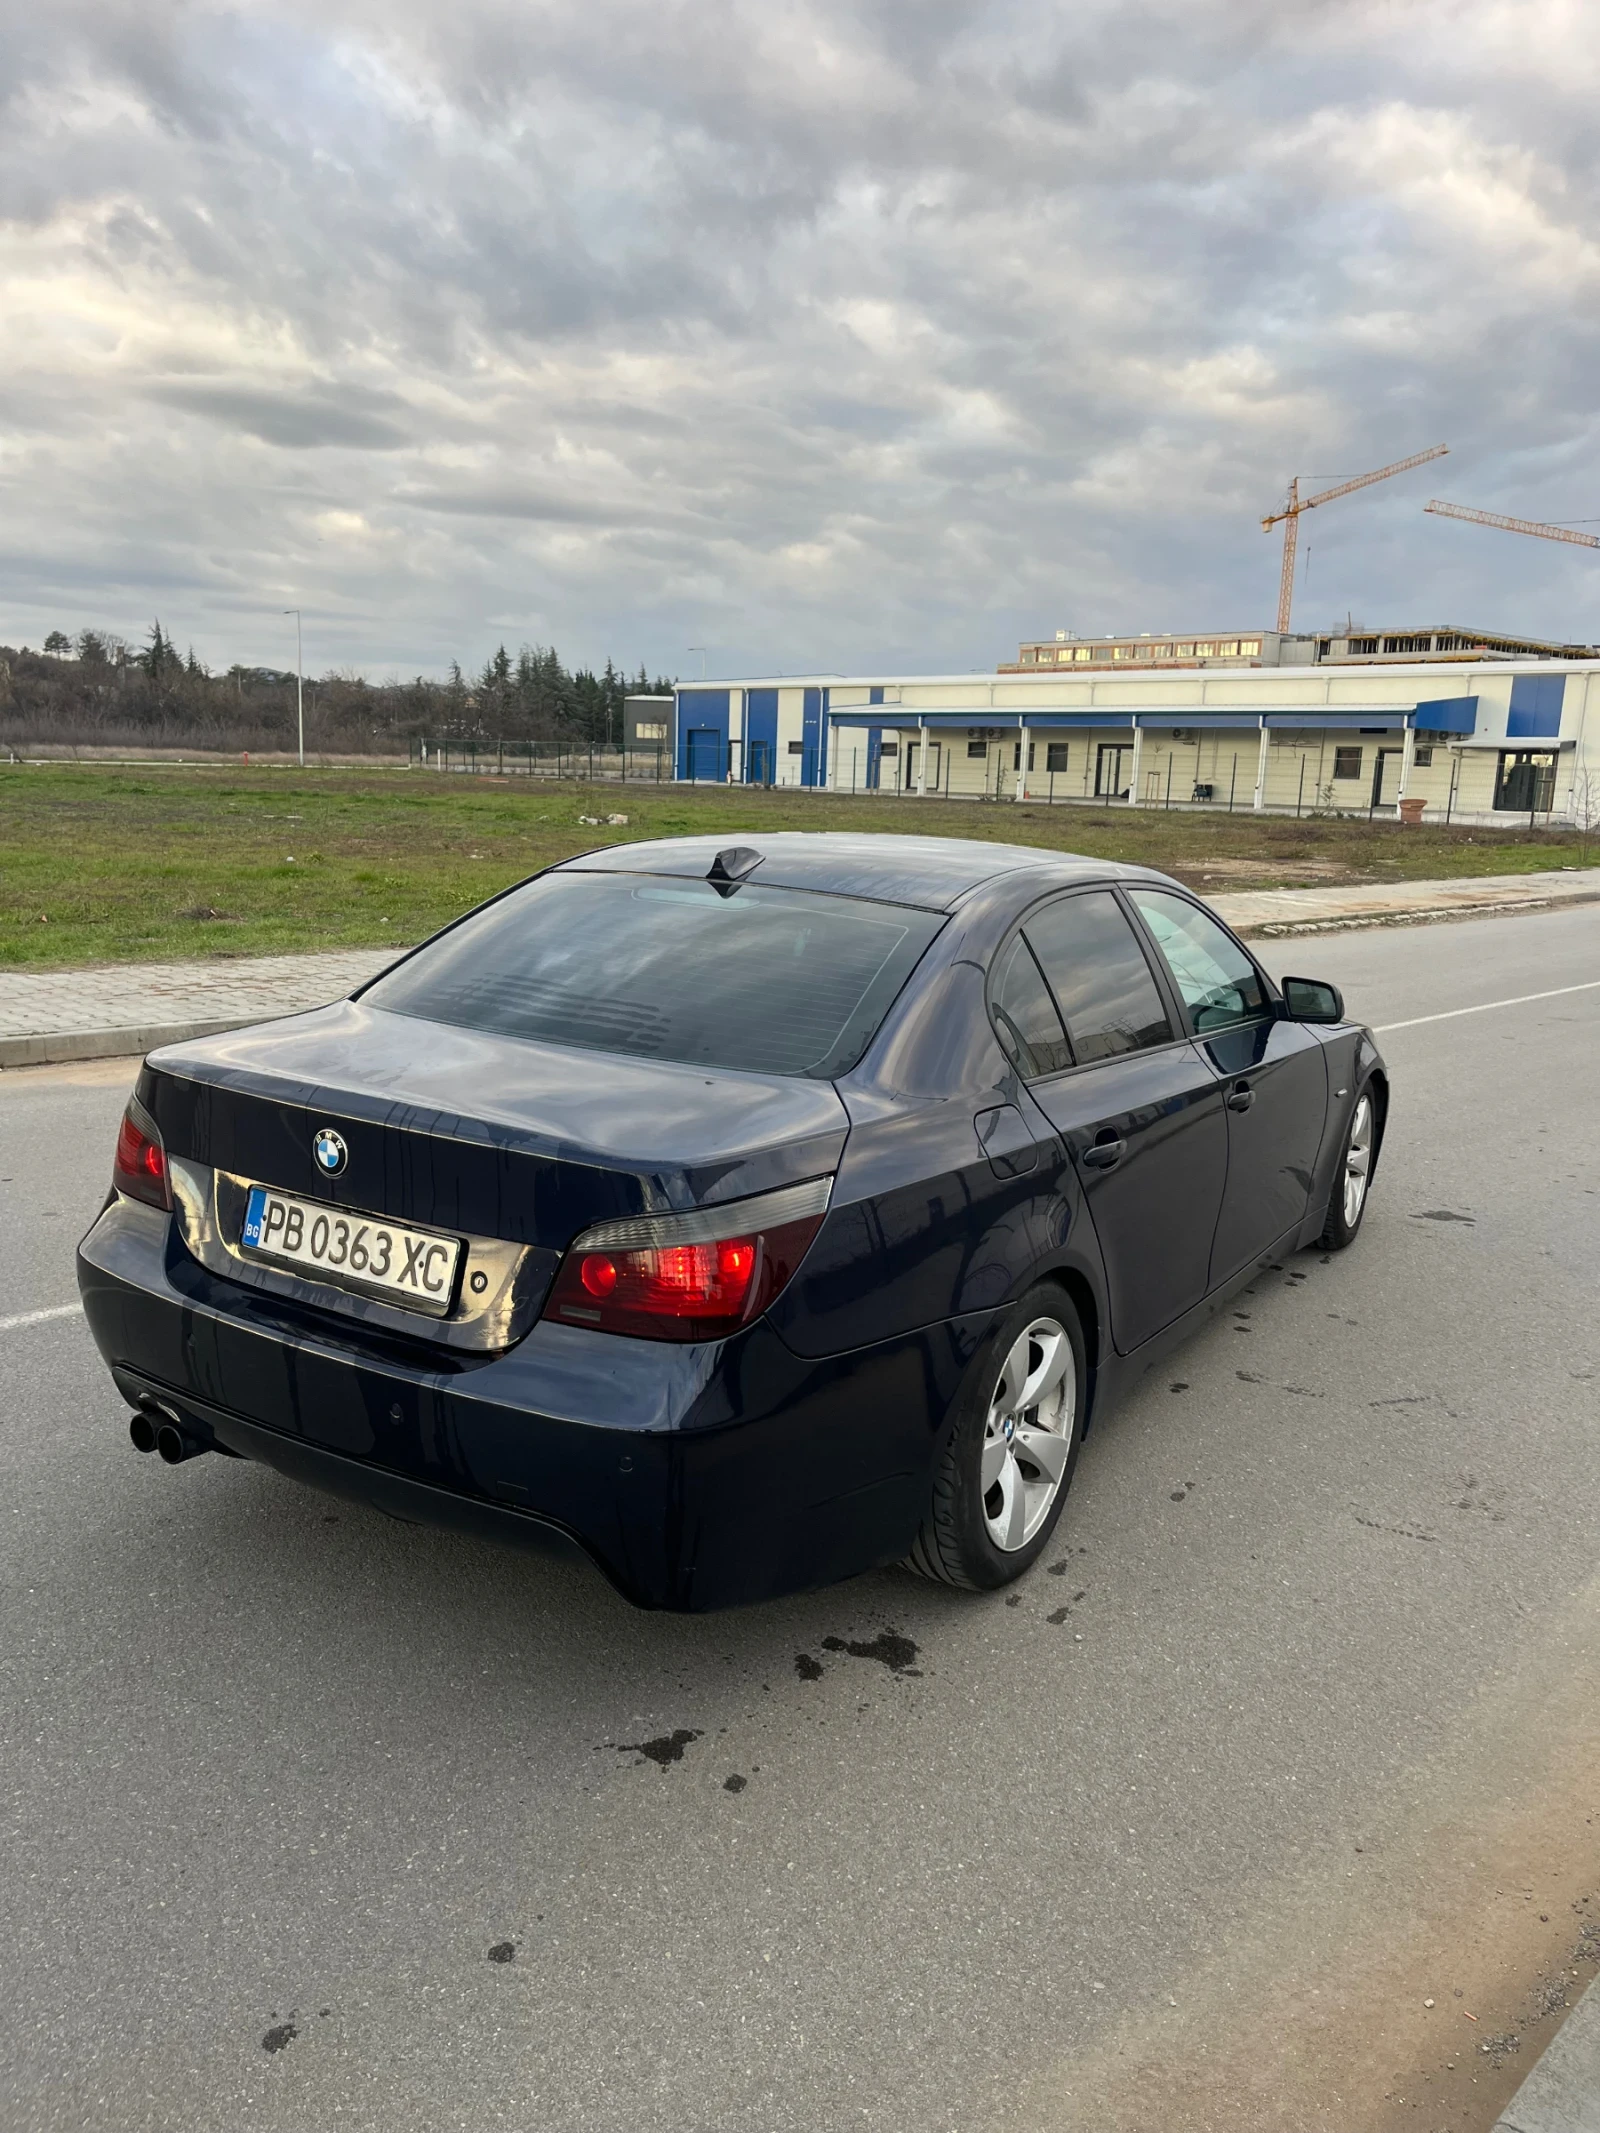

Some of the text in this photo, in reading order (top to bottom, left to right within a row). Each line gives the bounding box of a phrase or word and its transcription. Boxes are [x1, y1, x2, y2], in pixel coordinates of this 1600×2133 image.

[315, 1132, 343, 1149] BMW
[245, 1223, 260, 1239] BG
[263, 1200, 448, 1292] PB 0363 XC
